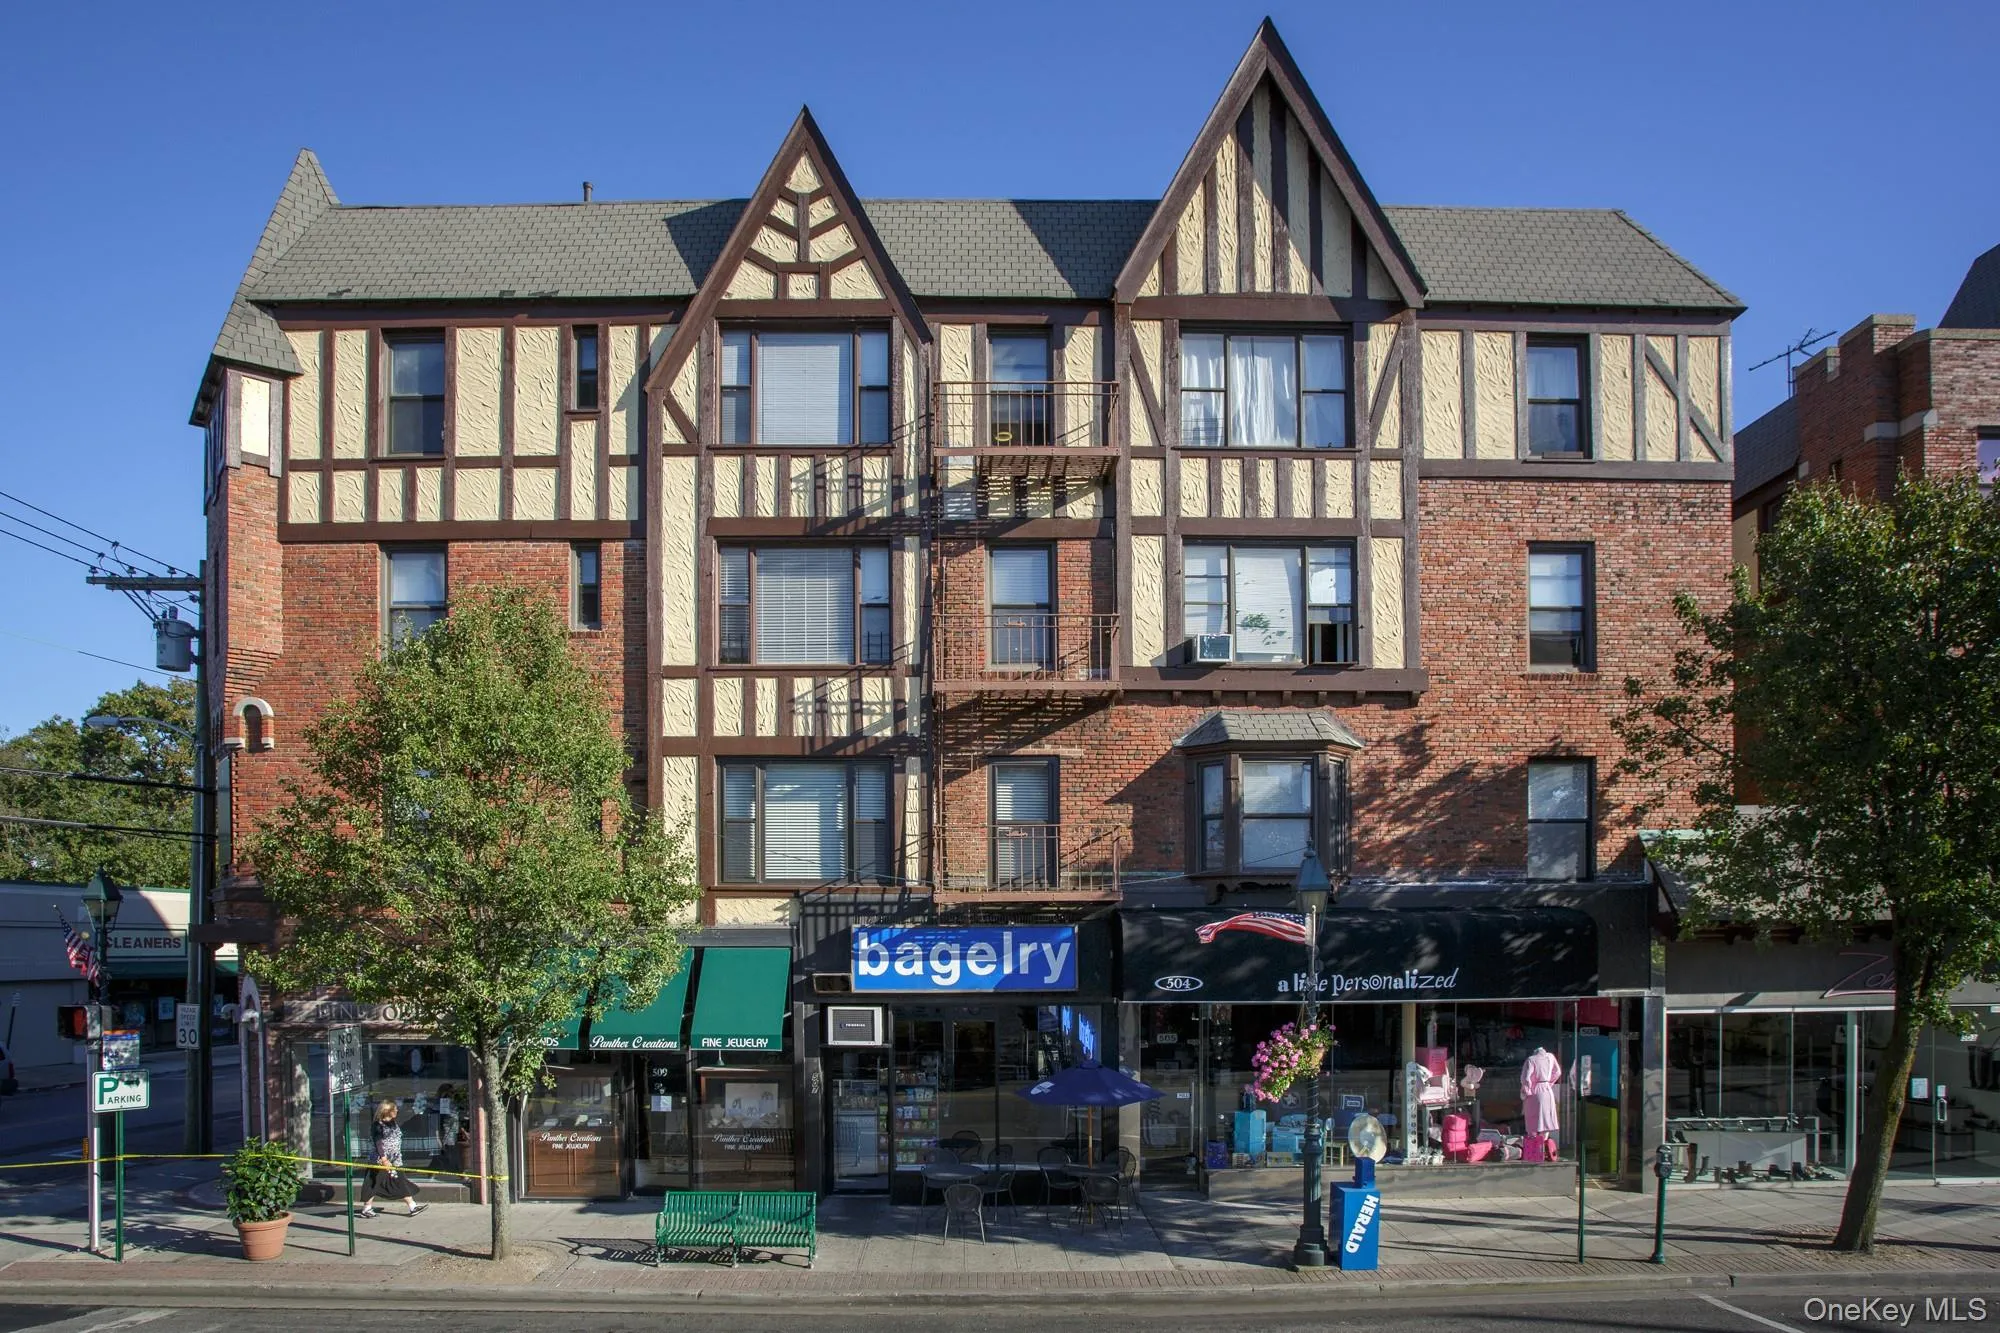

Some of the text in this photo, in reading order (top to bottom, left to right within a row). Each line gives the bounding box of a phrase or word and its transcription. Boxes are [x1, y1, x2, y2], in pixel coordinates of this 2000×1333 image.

[106, 937, 182, 949] CLEANERS
[858, 931, 1071, 986] bagelry
[1166, 978, 1191, 989] 504
[1277, 968, 1459, 997] a lile personalized
[179, 1029, 197, 1044] 30
[338, 1033, 353, 1045] NO
[589, 1035, 678, 1049] Panther Creations
[701, 1038, 769, 1048] FINE JEWELRY
[337, 1048, 355, 1059] TURN
[341, 1061, 352, 1071] ON
[652, 1067, 668, 1077] 509
[99, 1077, 142, 1105] PARKING
[539, 1132, 602, 1142] Panther Creations
[711, 1133, 774, 1143] Panther Creations
[1345, 1194, 1379, 1254] HERALD
